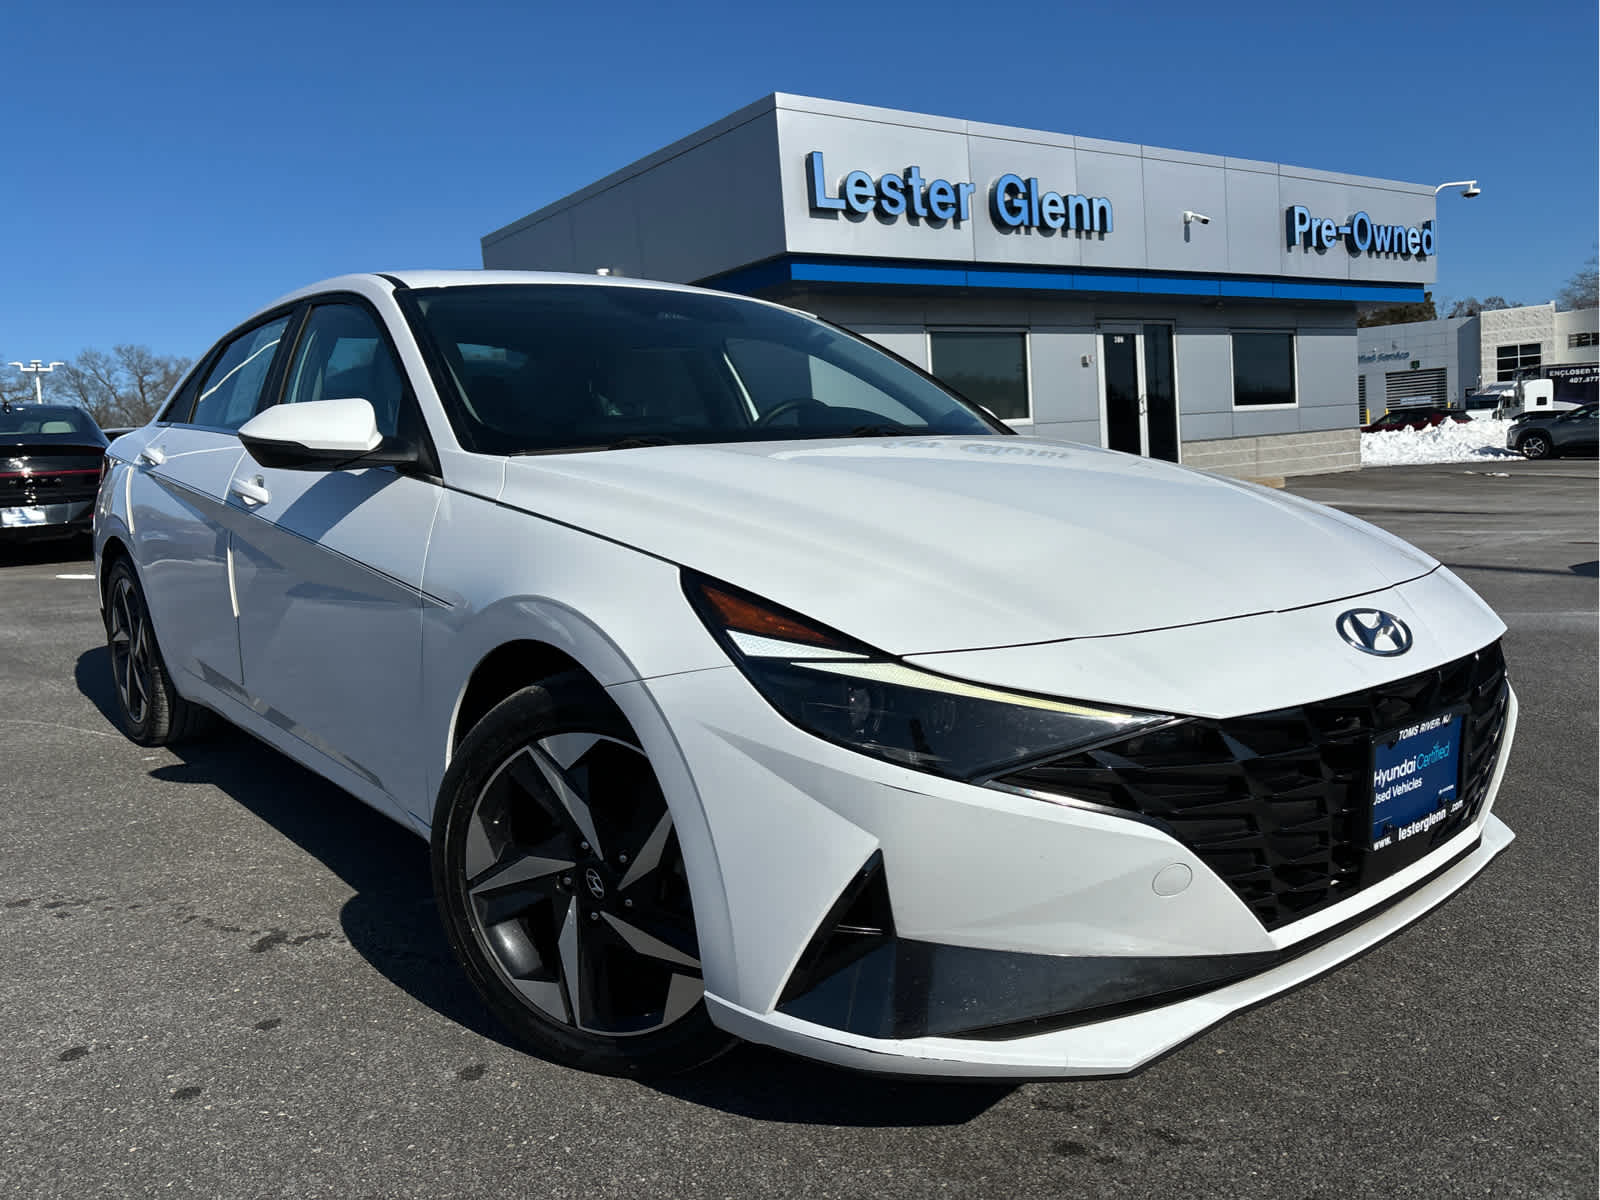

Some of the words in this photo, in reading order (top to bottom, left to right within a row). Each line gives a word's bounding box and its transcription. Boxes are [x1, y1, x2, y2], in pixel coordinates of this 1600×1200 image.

[805, 150, 975, 224] Lester
[991, 172, 1114, 234] Glenn
[1288, 204, 1436, 256] Pre-Owned
[1398, 724, 1419, 741] TOMS
[1373, 755, 1417, 788] Hyundai
[1416, 739, 1451, 770] Certified
[1392, 776, 1424, 798] Vehicles
[1398, 808, 1447, 841] lesterglenn
